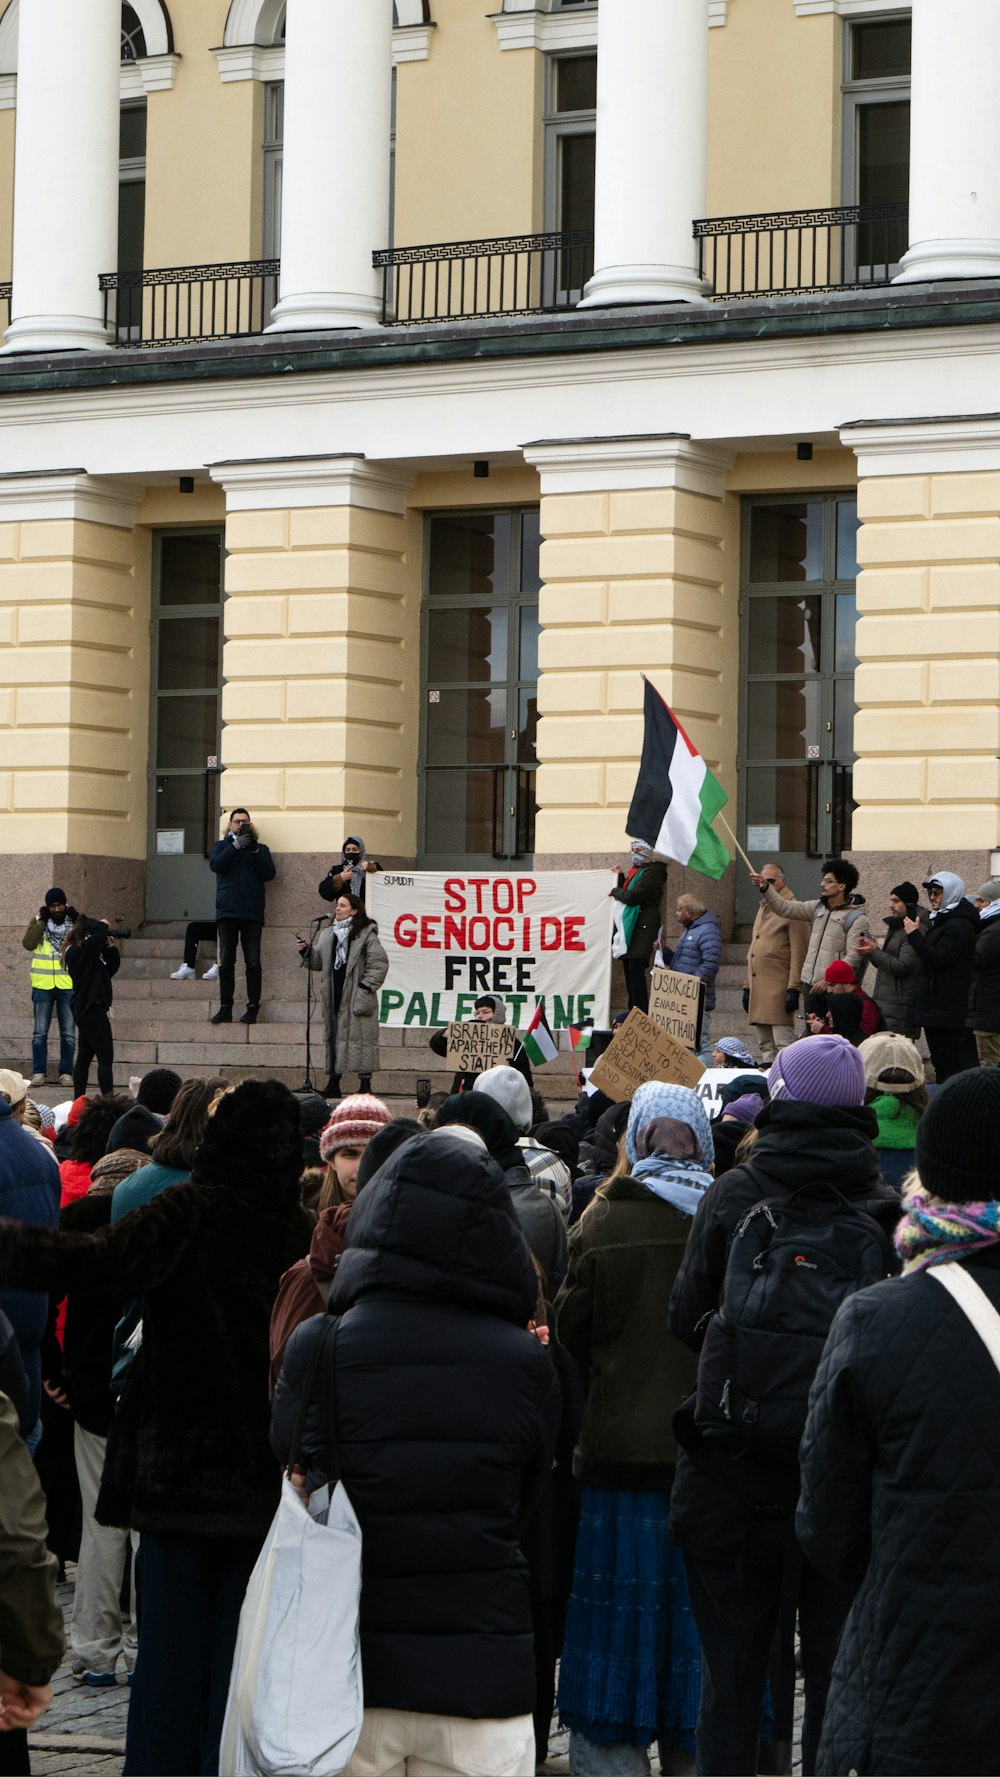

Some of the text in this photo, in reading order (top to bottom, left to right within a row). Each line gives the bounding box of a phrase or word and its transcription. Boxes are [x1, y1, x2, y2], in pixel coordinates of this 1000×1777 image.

[444, 878, 537, 914] STOP
[394, 913, 586, 951] GENOCIDE
[445, 955, 536, 992] FREE
[378, 989, 596, 1029] PALETNE
[654, 998, 688, 1015] ENABLE
[449, 1039, 513, 1056] APARTHEID
[450, 1023, 516, 1044] ISRAEL IS AN
[630, 1011, 689, 1065] FROM THE
[459, 1054, 499, 1071] STATE
[615, 1038, 661, 1080] SEA MAY
[624, 1027, 690, 1084] RIVER TO THE
[600, 1064, 620, 1084] AND
